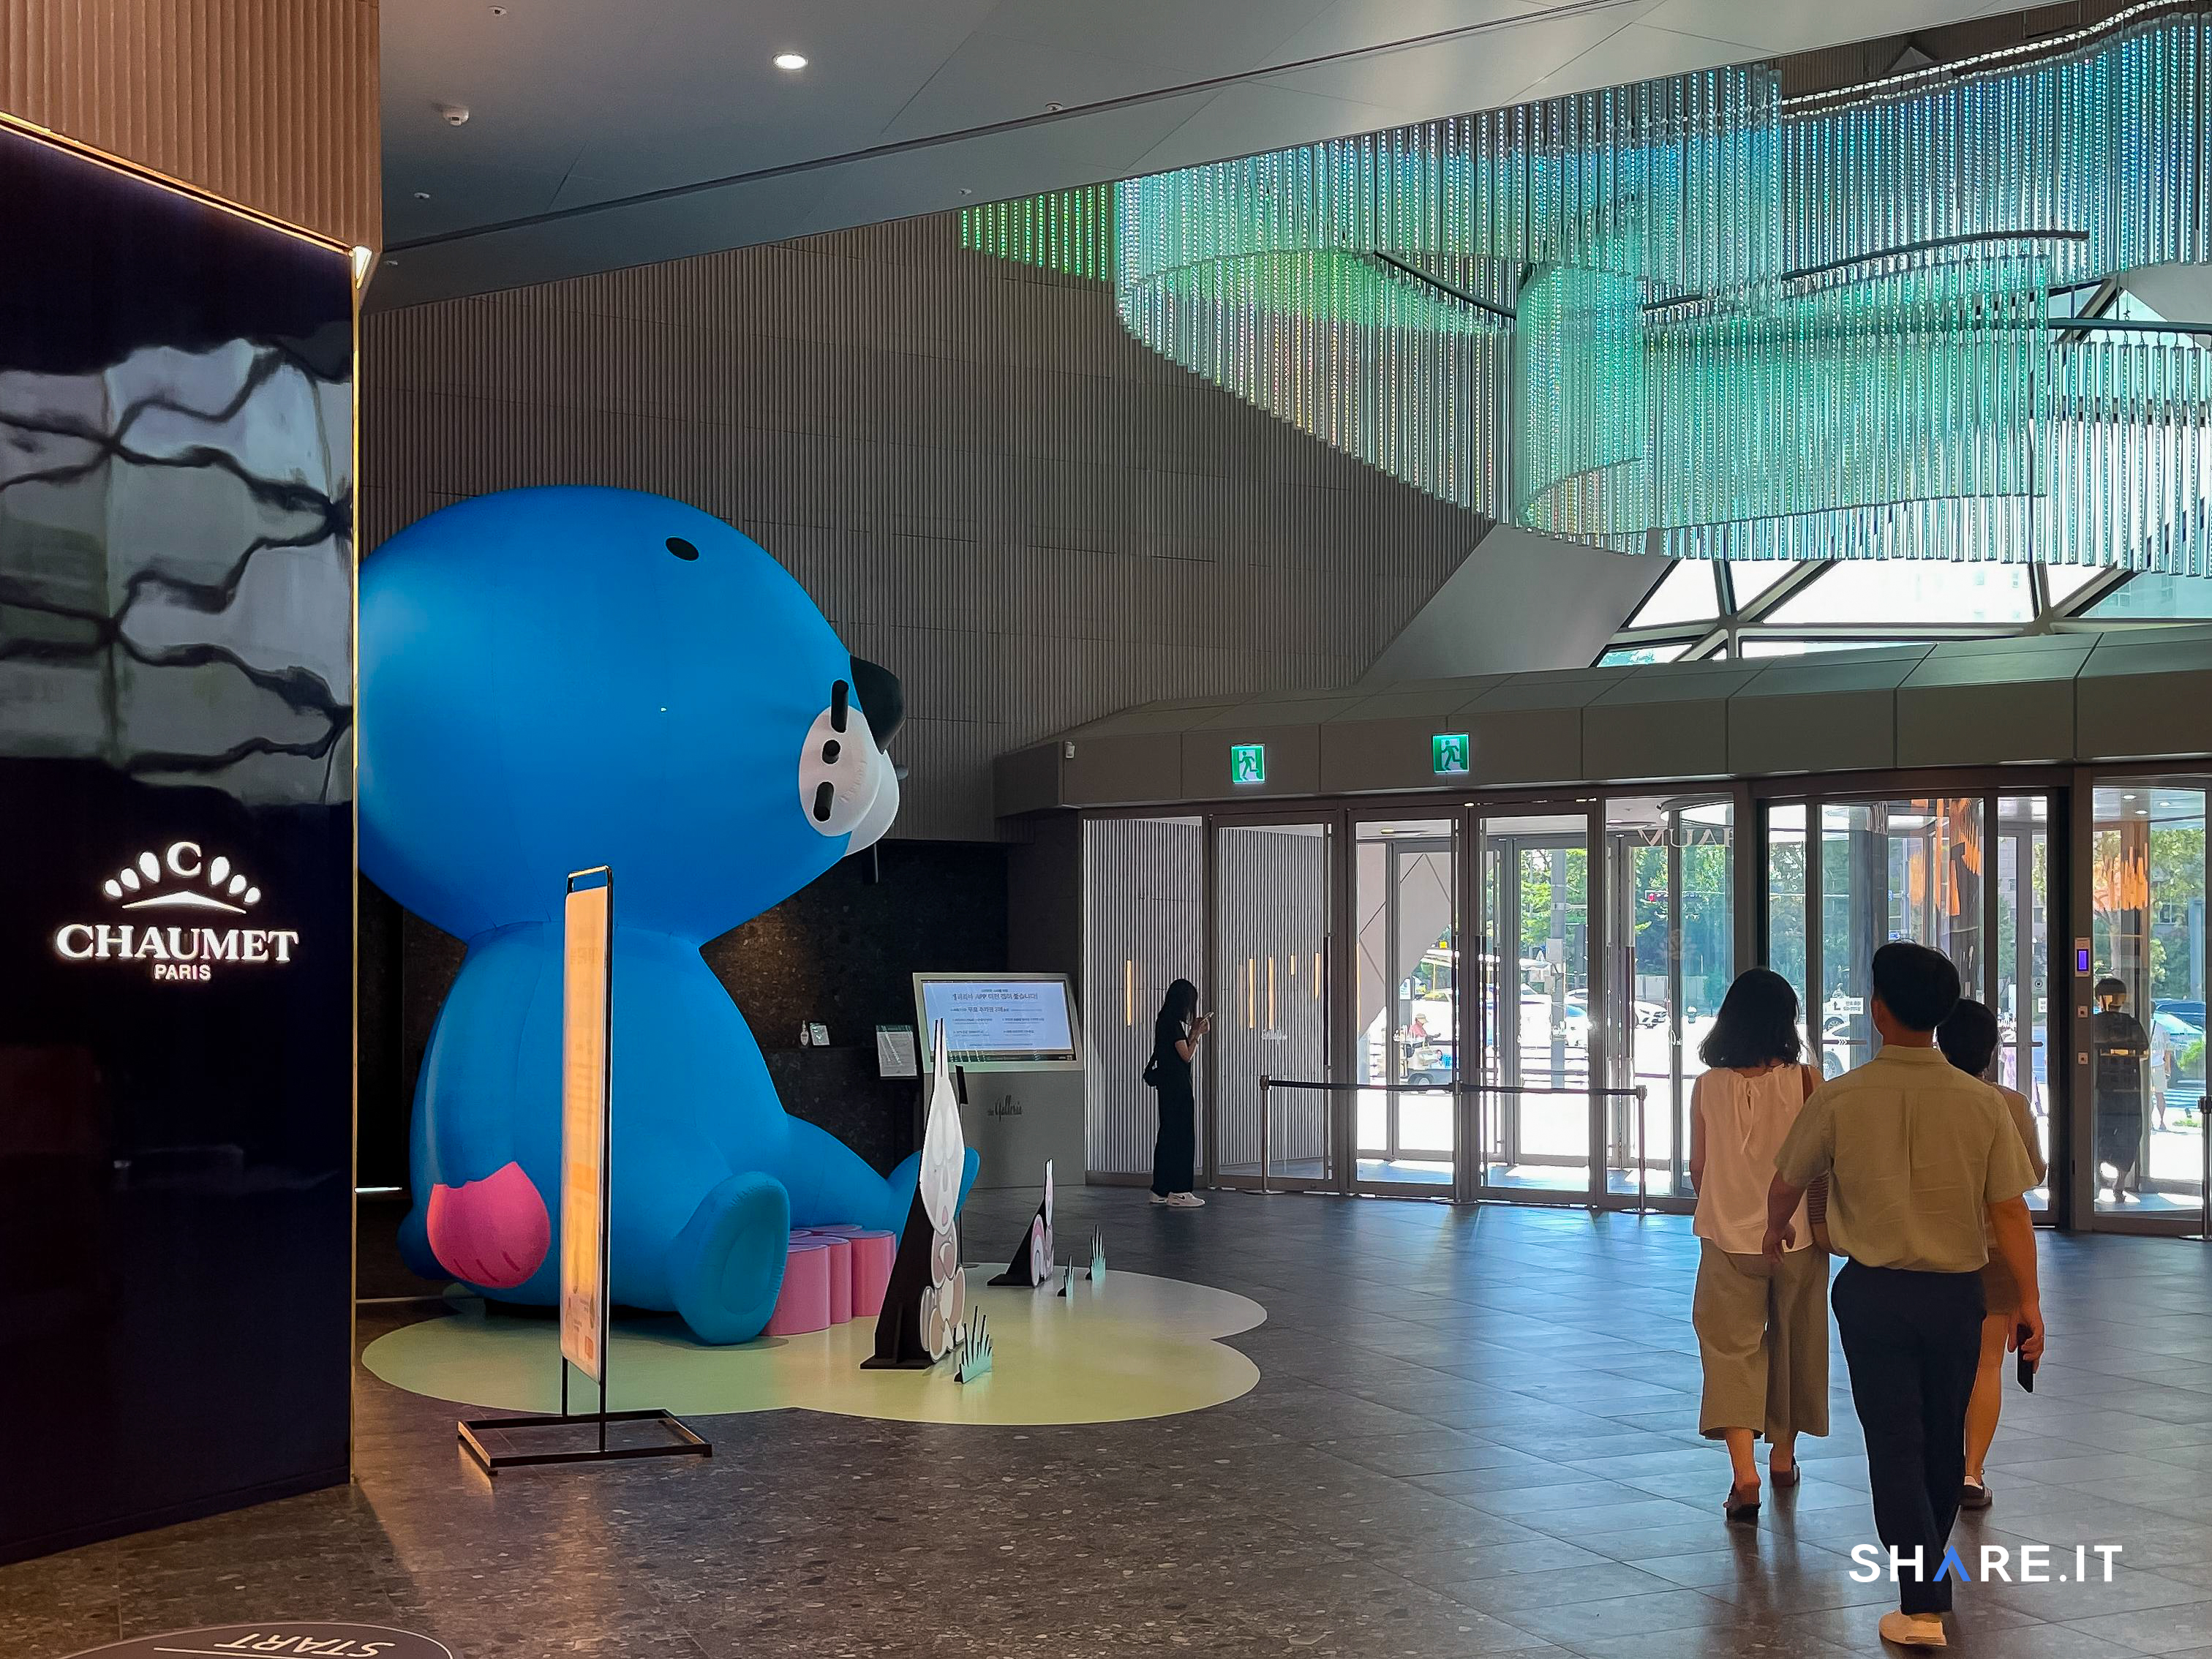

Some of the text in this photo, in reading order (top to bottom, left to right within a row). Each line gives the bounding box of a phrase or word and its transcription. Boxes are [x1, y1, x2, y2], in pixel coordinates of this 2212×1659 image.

[167, 841, 203, 877] C
[56, 923, 299, 962] CHAUMET
[154, 964, 211, 980] PARIS
[213, 1633, 396, 1658] START
